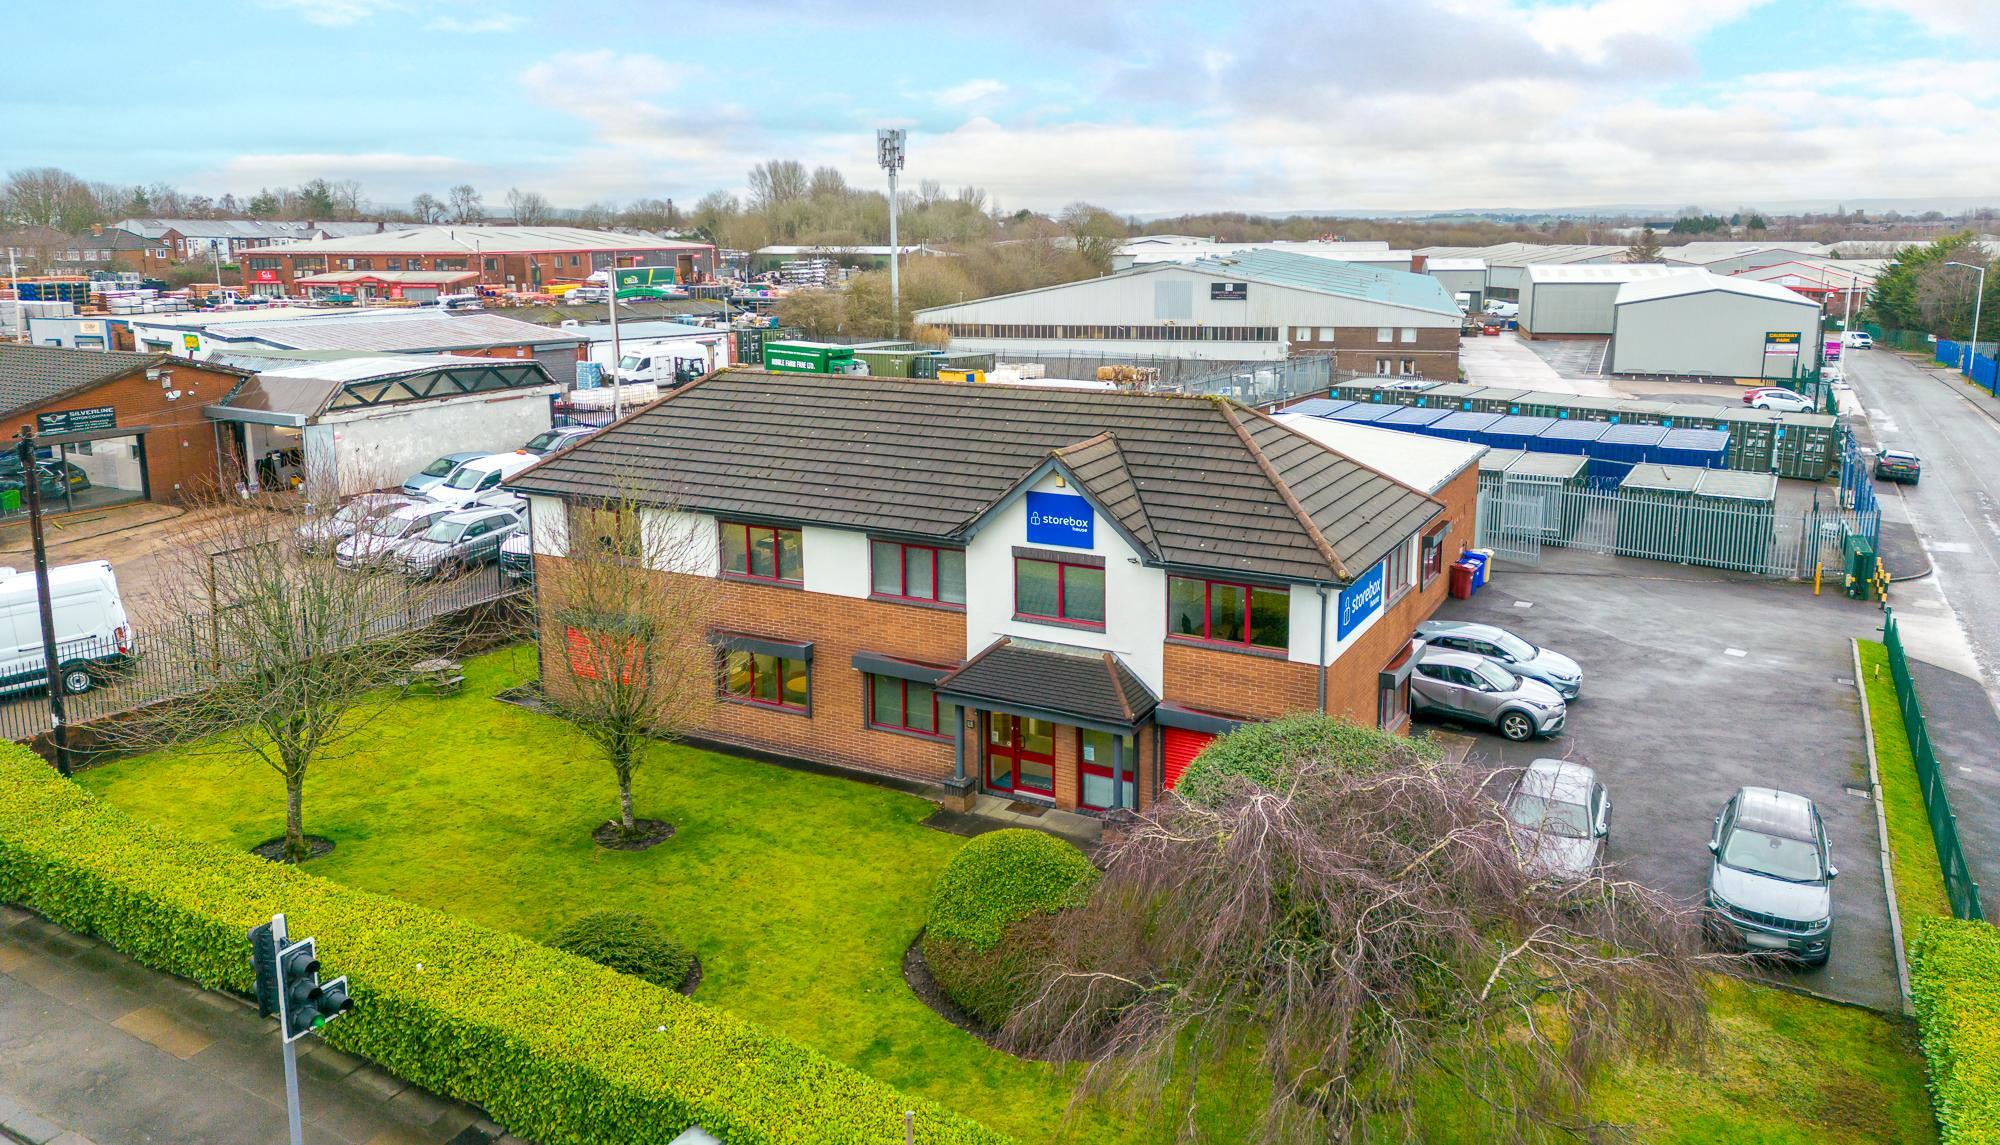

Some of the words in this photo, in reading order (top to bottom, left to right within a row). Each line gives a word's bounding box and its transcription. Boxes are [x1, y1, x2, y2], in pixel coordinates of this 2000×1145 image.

[69, 407, 114, 417] SILVERLINE
[1042, 515, 1088, 528] storebox
[1351, 577, 1382, 614] storebox
